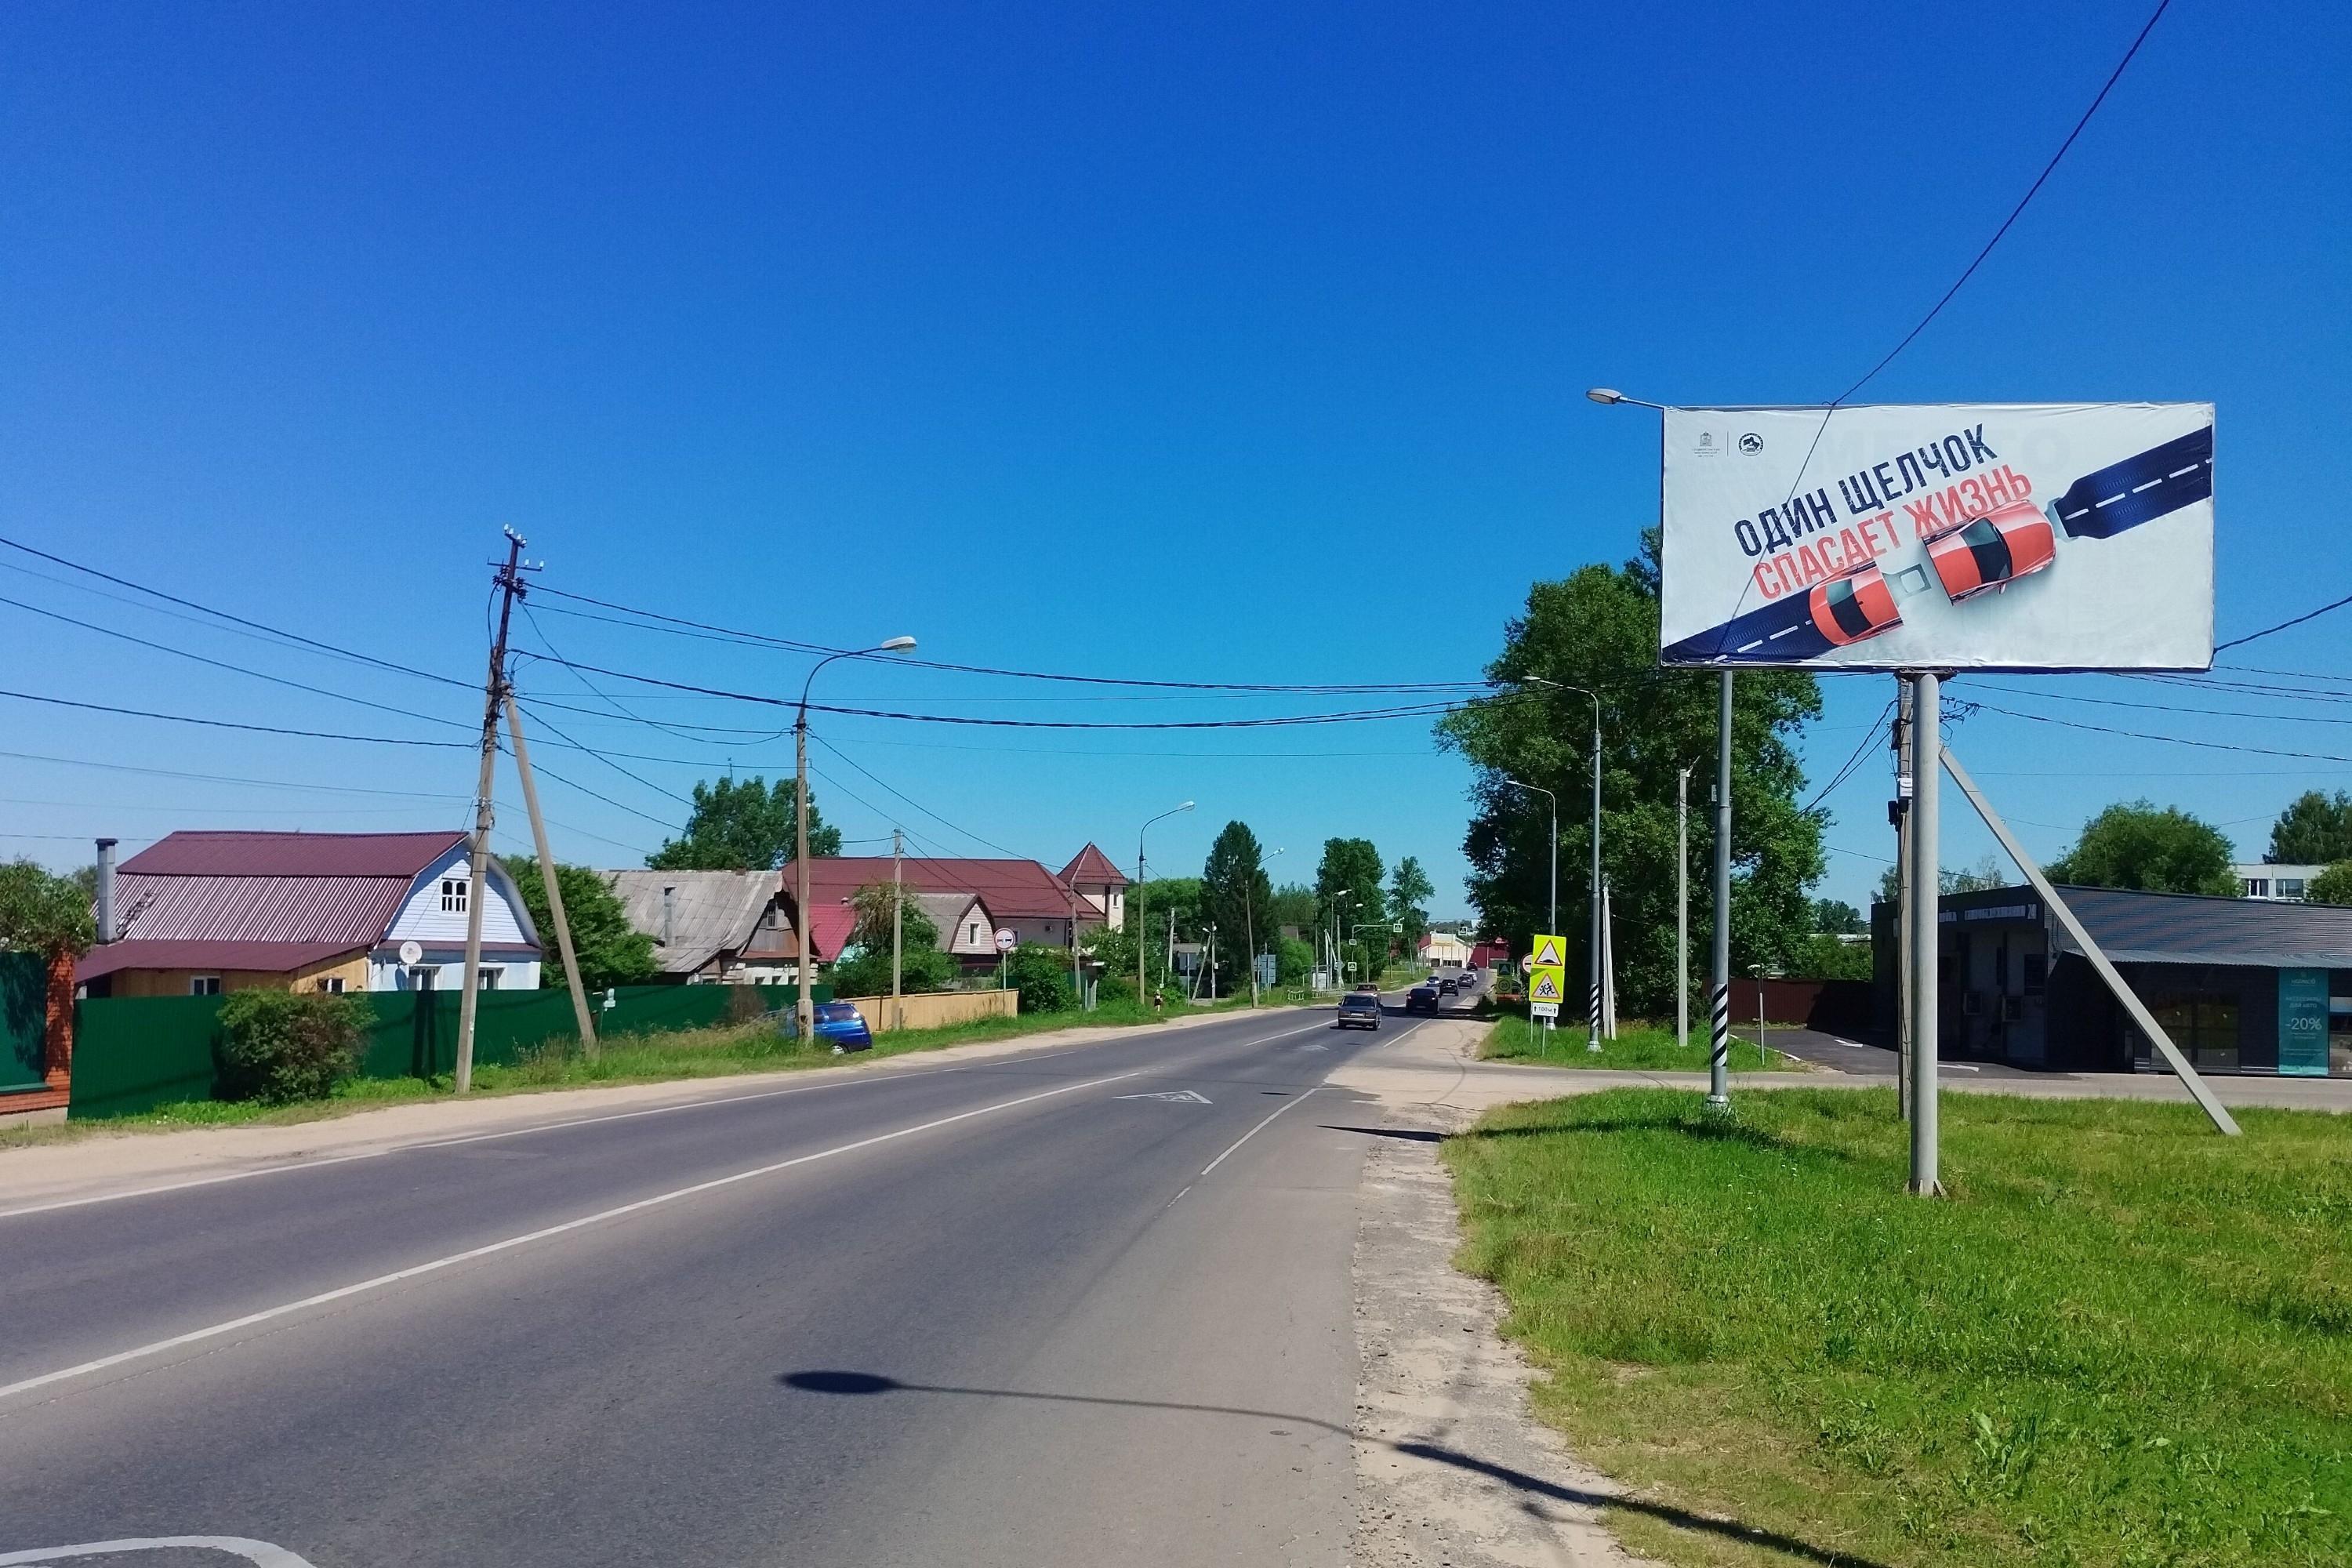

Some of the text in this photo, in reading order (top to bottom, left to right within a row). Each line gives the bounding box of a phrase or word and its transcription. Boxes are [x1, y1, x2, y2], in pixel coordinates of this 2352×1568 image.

[1733, 423, 1998, 557] ОДИН ЩЕЛЧОК
[1753, 464, 2032, 600] СПАСАЕТ ЖИЗНЬ
[2285, 1017, 2322, 1030] -20%
